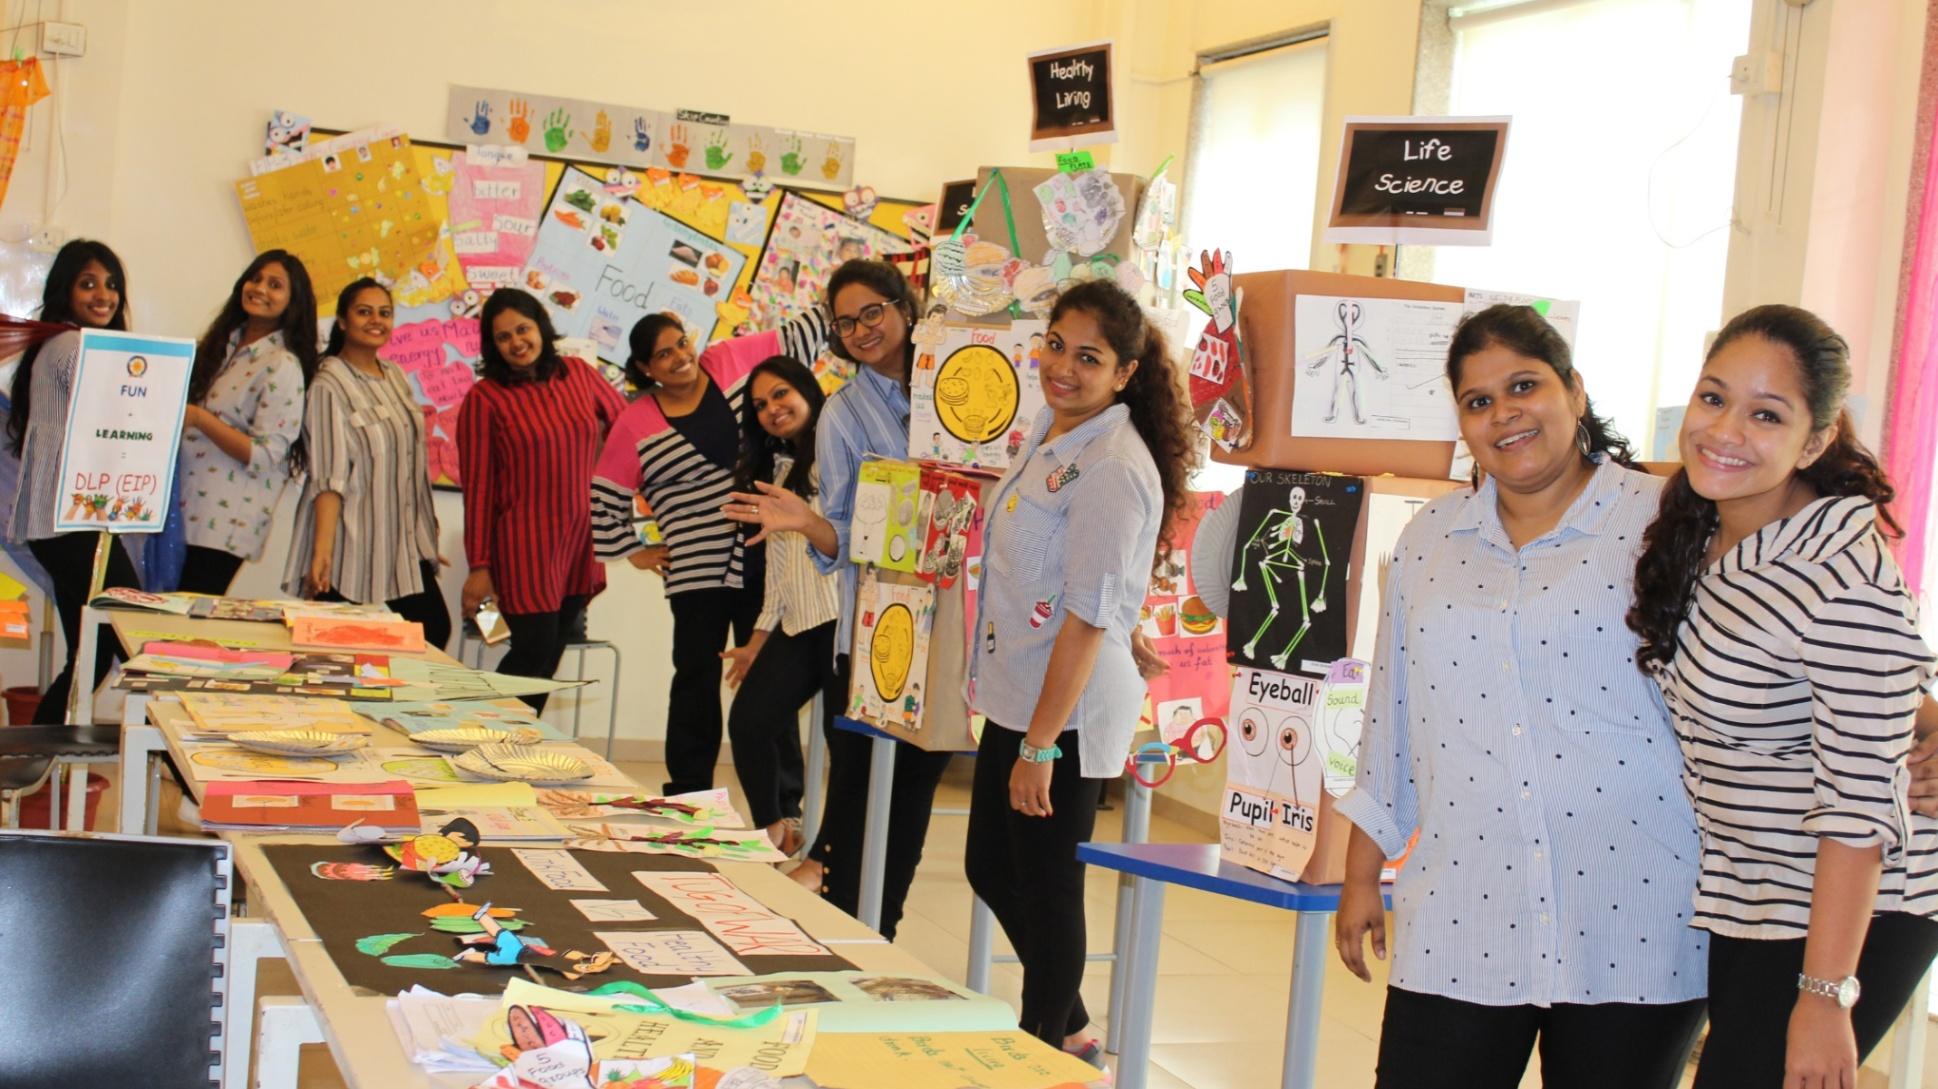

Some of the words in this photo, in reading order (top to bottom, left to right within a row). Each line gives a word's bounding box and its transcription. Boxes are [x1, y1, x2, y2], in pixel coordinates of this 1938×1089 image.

[1050, 59, 1094, 82] Healthy
[1055, 91, 1091, 109] Living
[1403, 138, 1452, 162] Life
[1374, 173, 1464, 195] Science
[594, 263, 655, 310] Food
[971, 329, 996, 344] Food
[121, 385, 147, 397] FUN
[96, 429, 153, 440] LEARNING
[75, 472, 110, 491] DLP
[116, 474, 157, 495] (EIP)
[1276, 473, 1333, 488] SKELETON
[1249, 671, 1314, 706] Eyeball
[1229, 792, 1274, 826] Pupil
[1282, 803, 1314, 832] Iris
[535, 1052, 551, 1065] 5
[750, 1040, 791, 1071] FOOD
